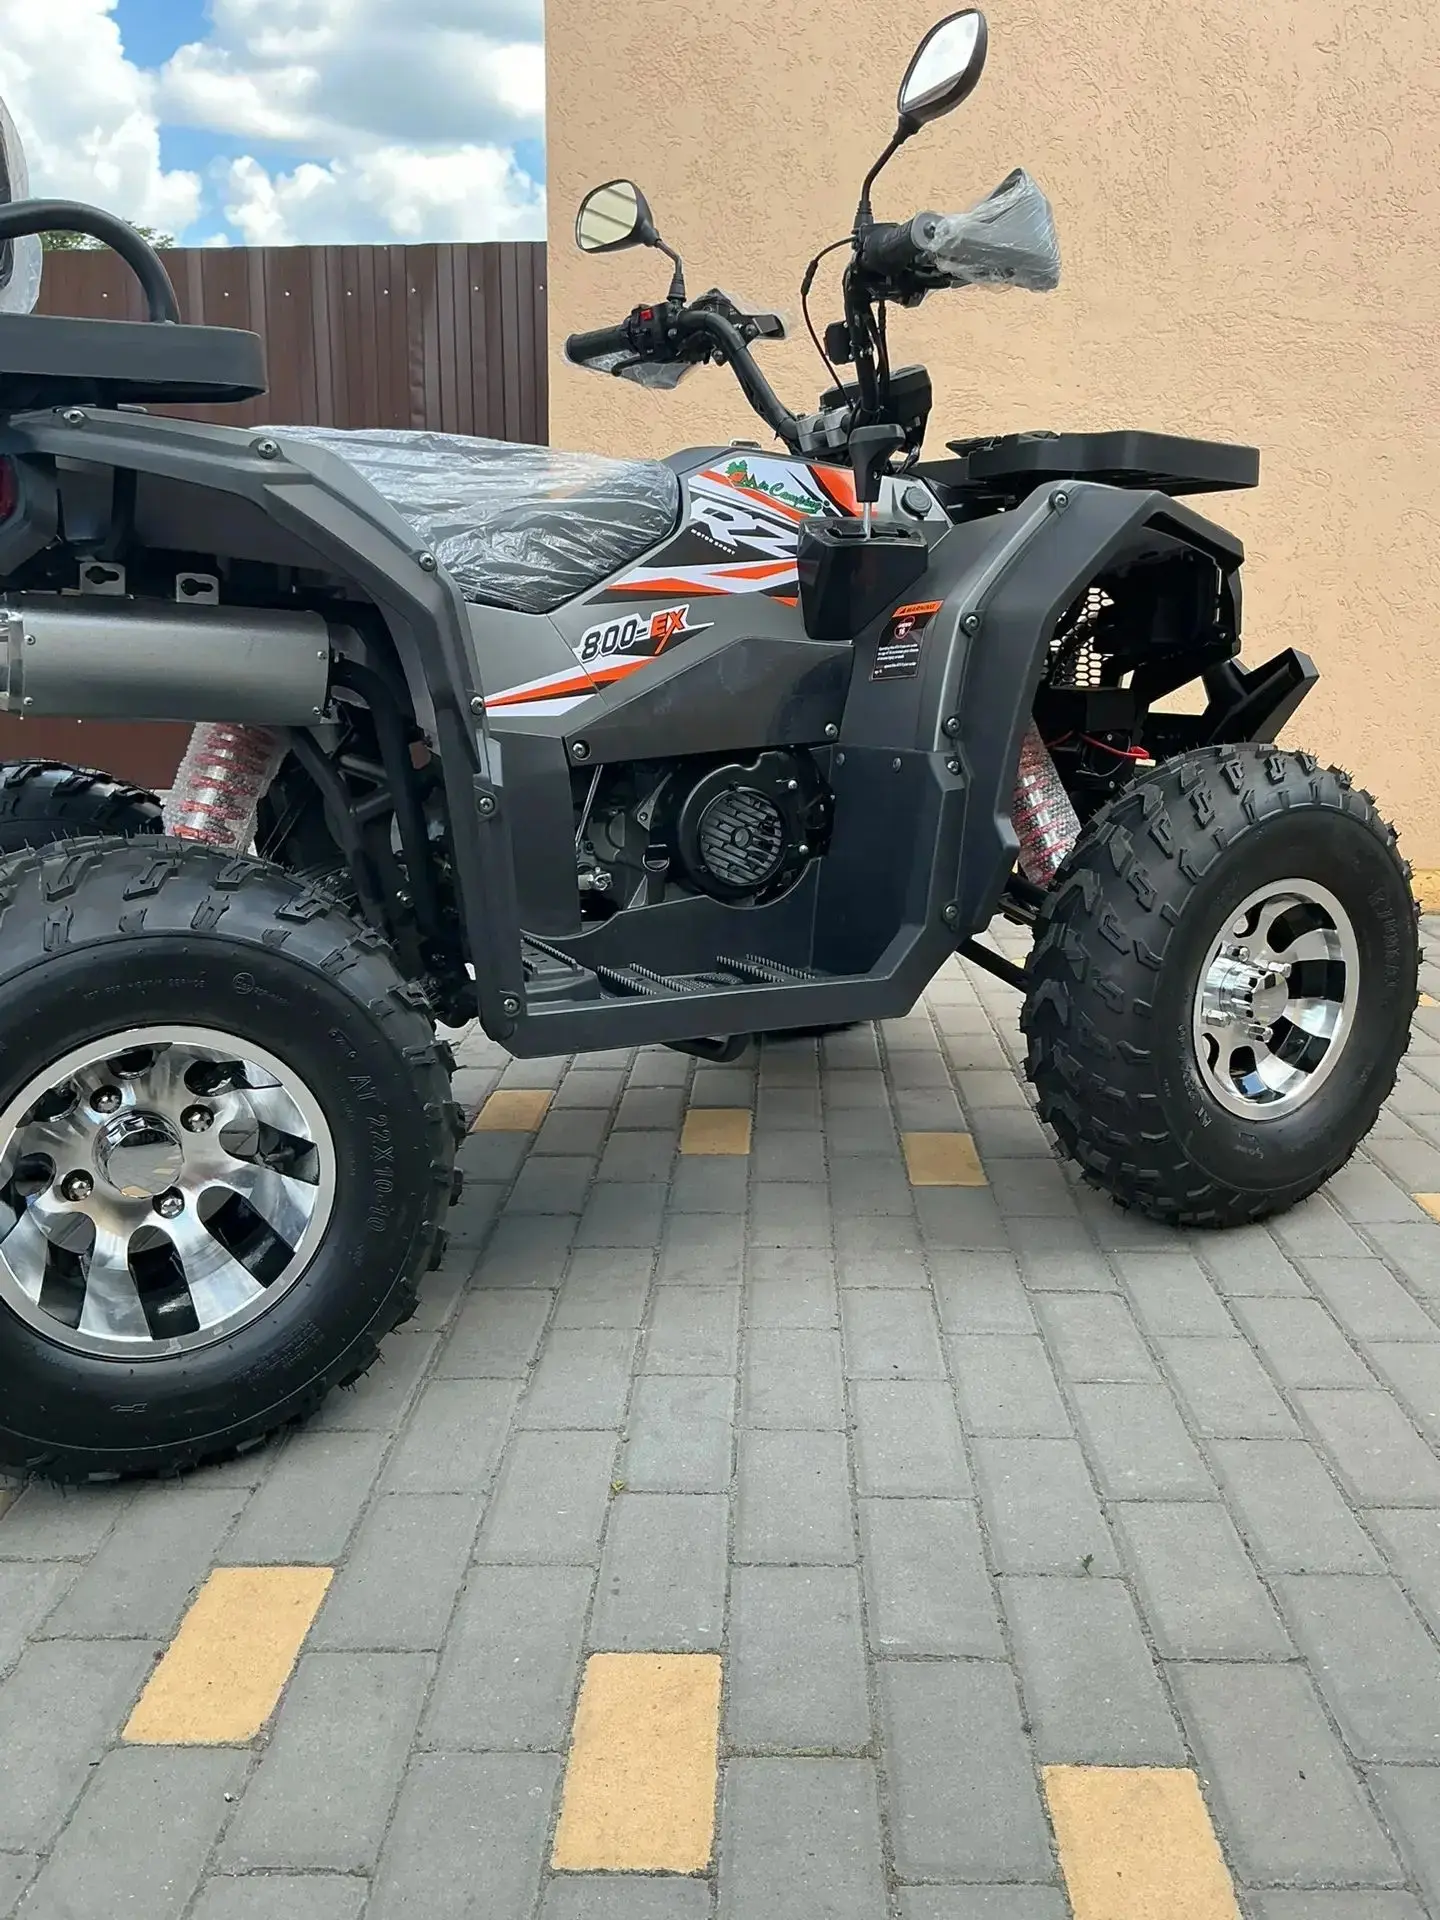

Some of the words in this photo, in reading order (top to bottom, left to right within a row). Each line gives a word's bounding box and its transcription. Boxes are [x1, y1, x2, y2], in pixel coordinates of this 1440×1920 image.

[690, 528, 714, 544] MOTOR
[714, 541, 736, 555] SPORT
[581, 608, 687, 661] 800-EX
